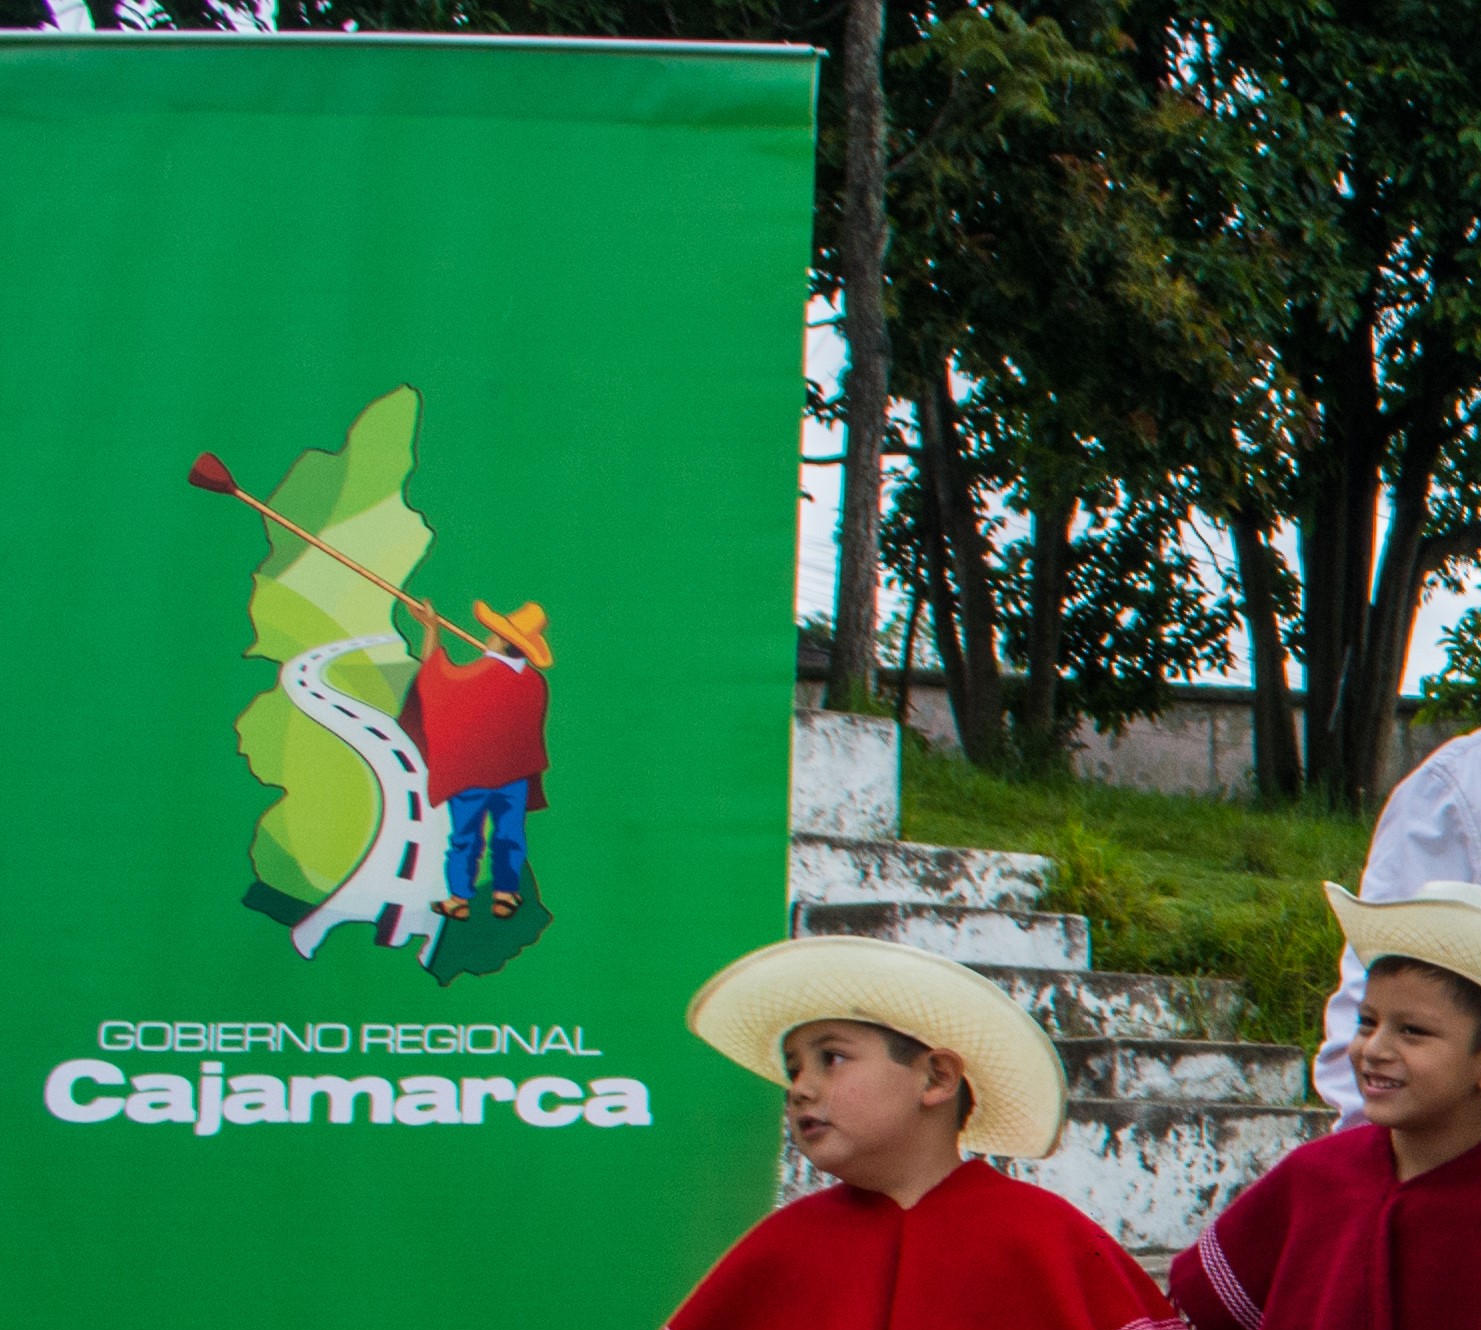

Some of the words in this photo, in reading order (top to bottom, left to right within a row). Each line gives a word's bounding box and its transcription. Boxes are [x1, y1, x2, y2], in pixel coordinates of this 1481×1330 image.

[101, 1020, 351, 1054] GOBIERNO
[361, 1023, 604, 1056] REGIONAL
[43, 1058, 654, 1136] Cajamarca
